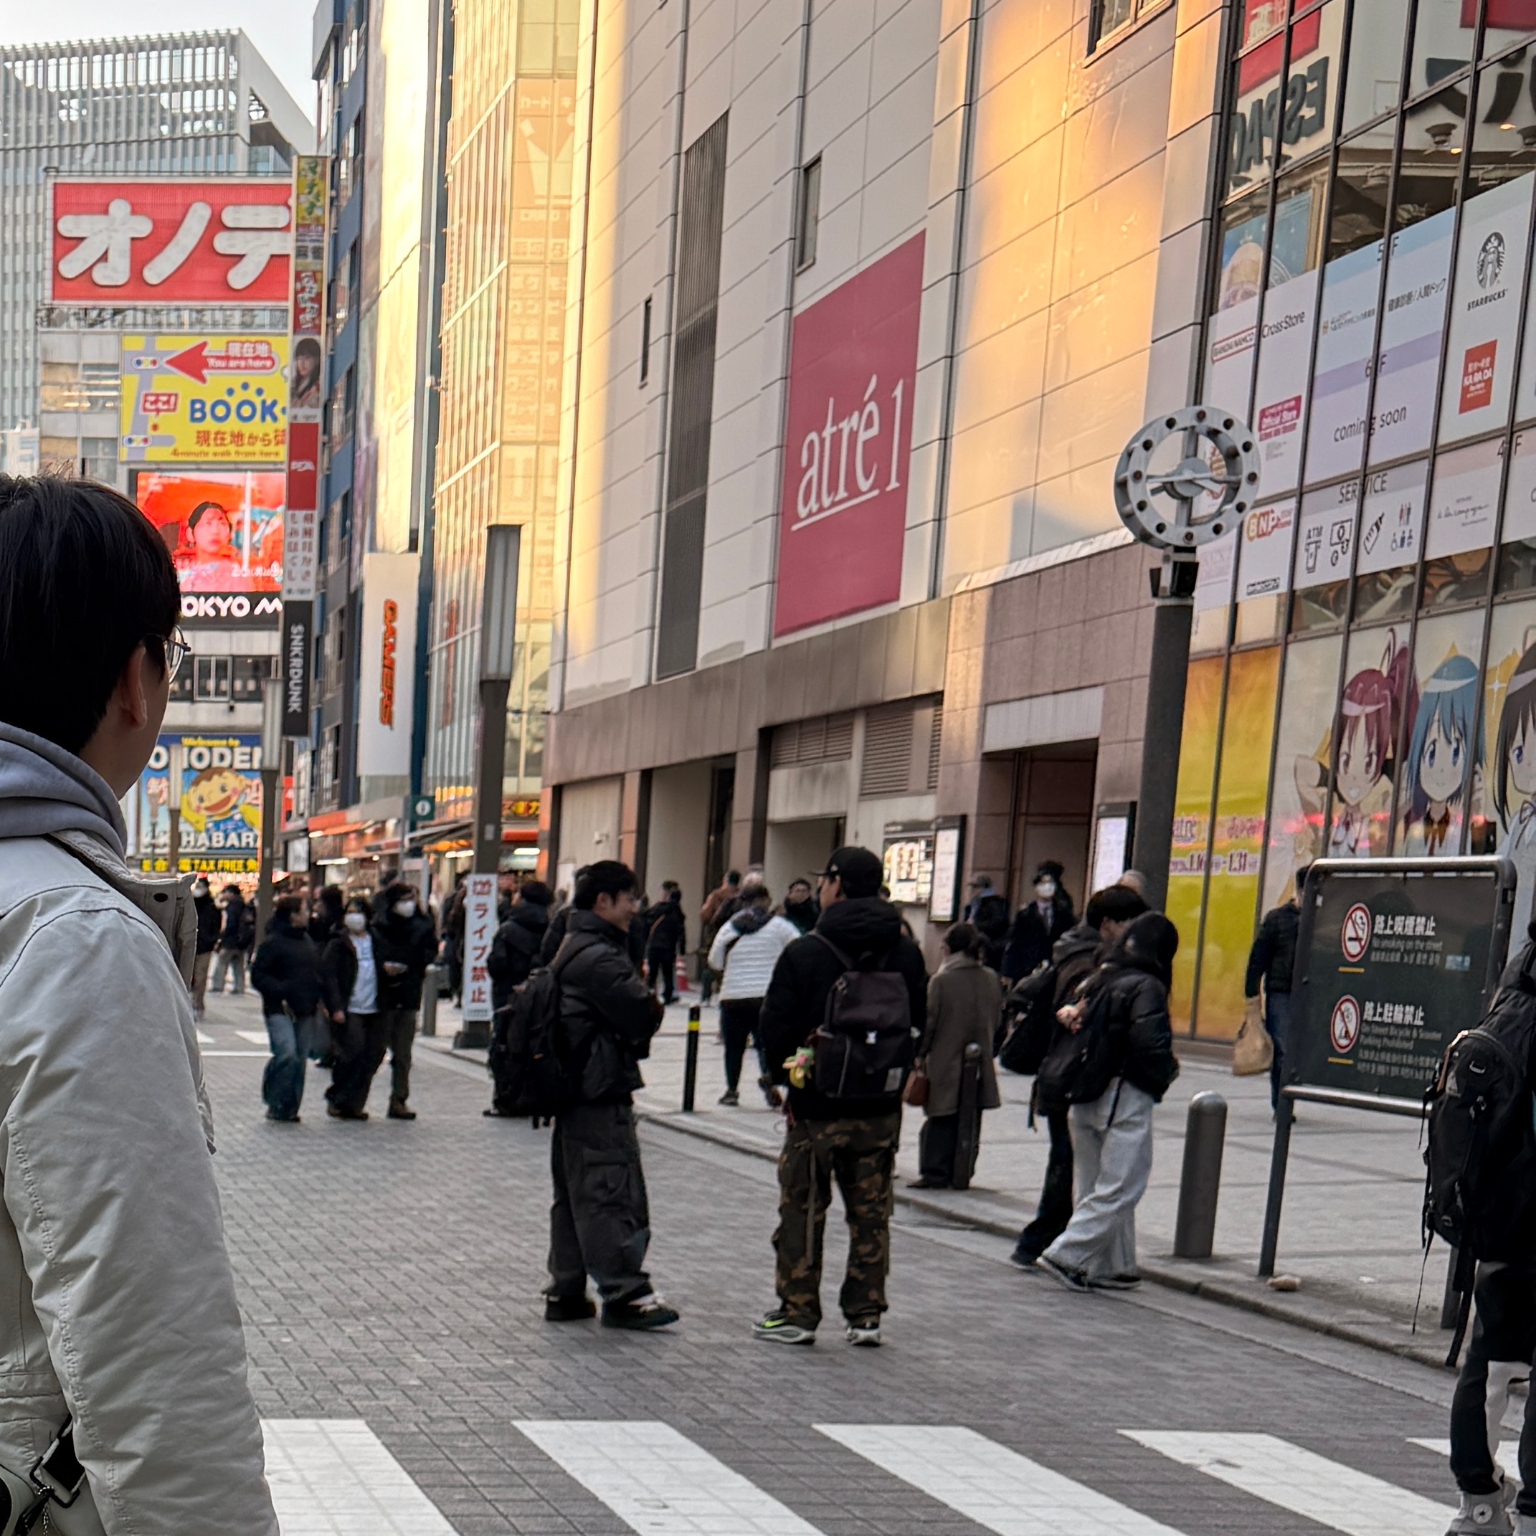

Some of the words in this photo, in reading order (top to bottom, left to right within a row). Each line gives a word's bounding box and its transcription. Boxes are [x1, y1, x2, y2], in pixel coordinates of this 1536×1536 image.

[1467, 288, 1506, 312] STARBUCKS
[189, 399, 278, 423] BOOK
[1333, 414, 1376, 443] coming
[1379, 405, 1407, 427] soon
[1339, 473, 1388, 504] SERVICE
[287, 623, 305, 713] SNKRDUNK
[379, 598, 398, 727] GAMERS
[193, 859, 215, 872] TAX
[217, 859, 244, 872] FREE
